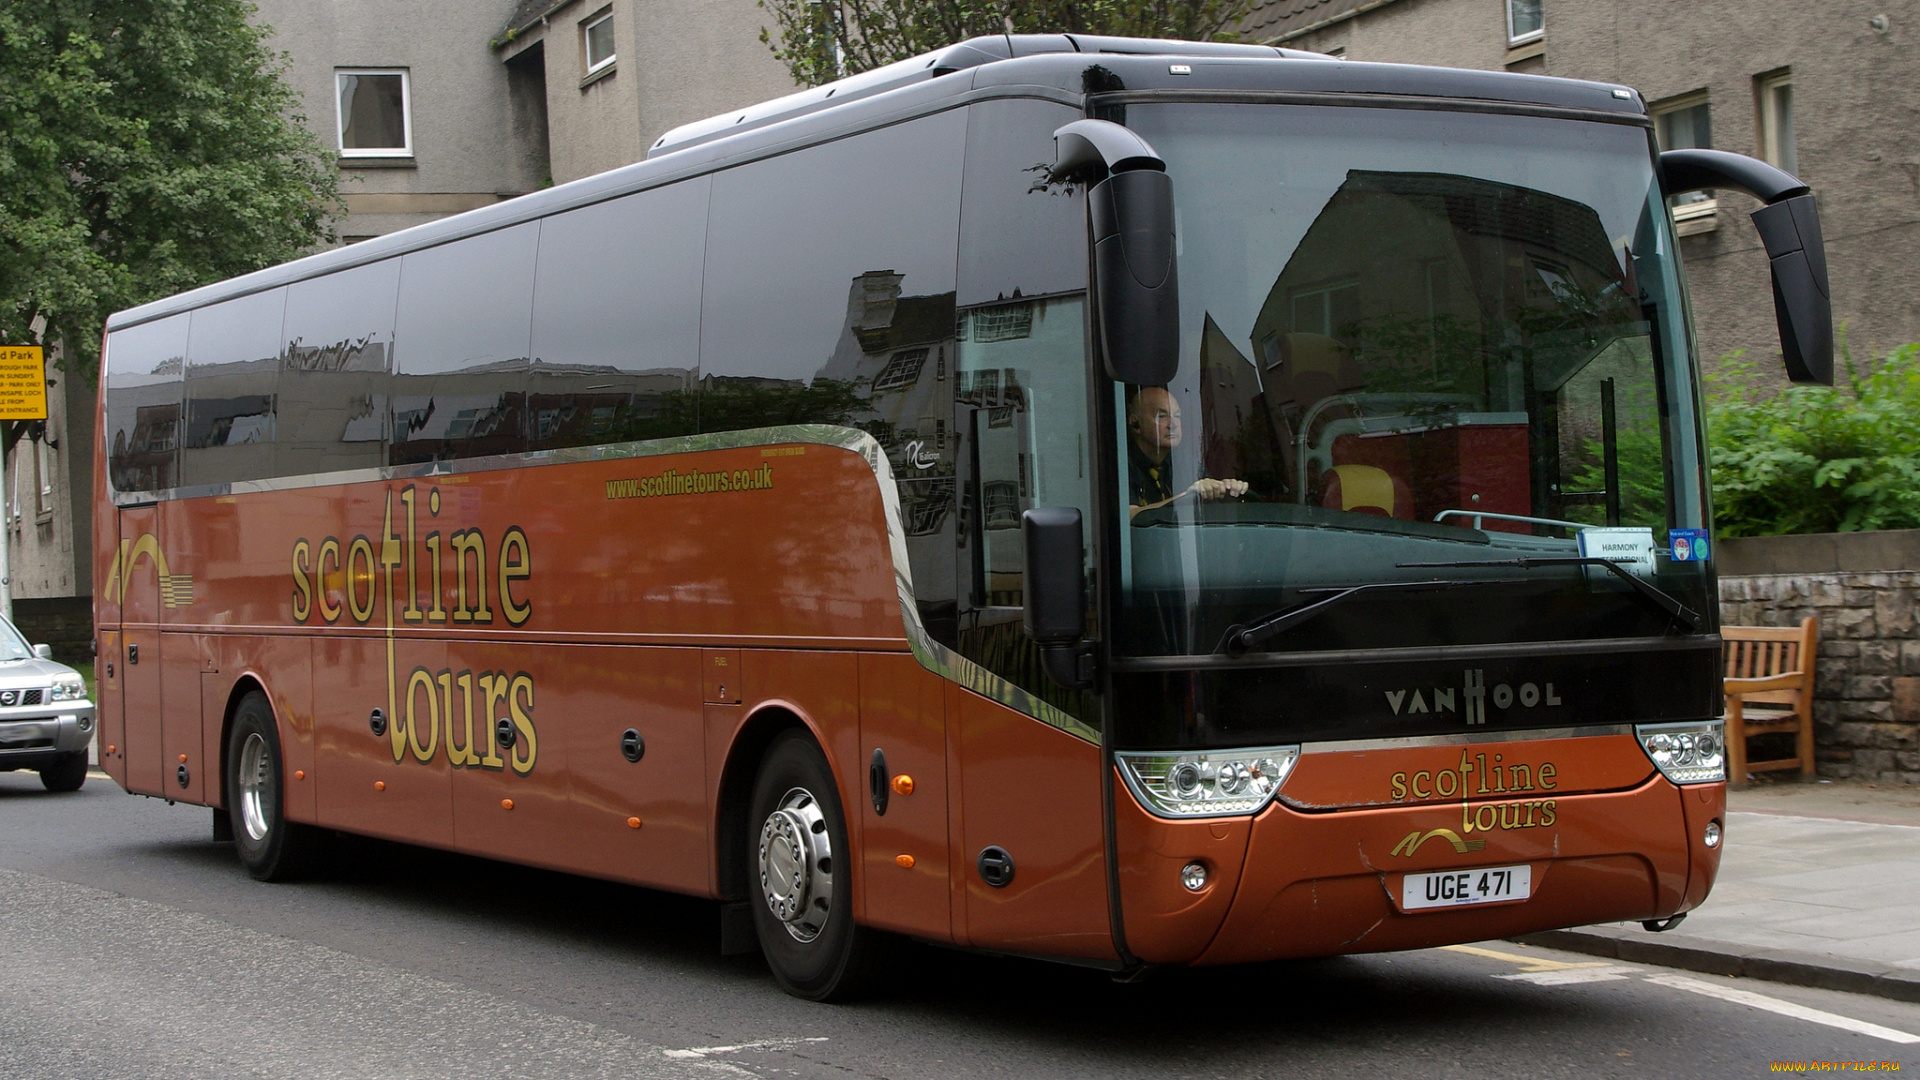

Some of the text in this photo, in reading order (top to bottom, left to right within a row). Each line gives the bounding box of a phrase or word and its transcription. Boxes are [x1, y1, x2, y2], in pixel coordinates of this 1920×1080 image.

[10, 351, 34, 360] Park
[606, 462, 773, 499] www.scotlinetours.co.uk
[291, 484, 532, 628] scotline
[1602, 543, 1639, 552] HARMONY
[714, 656, 728, 666] FUEL
[386, 652, 539, 777] tours
[1390, 748, 1558, 800] scotline
[1461, 800, 1557, 834] tours
[1425, 870, 1512, 901] UGE 471
